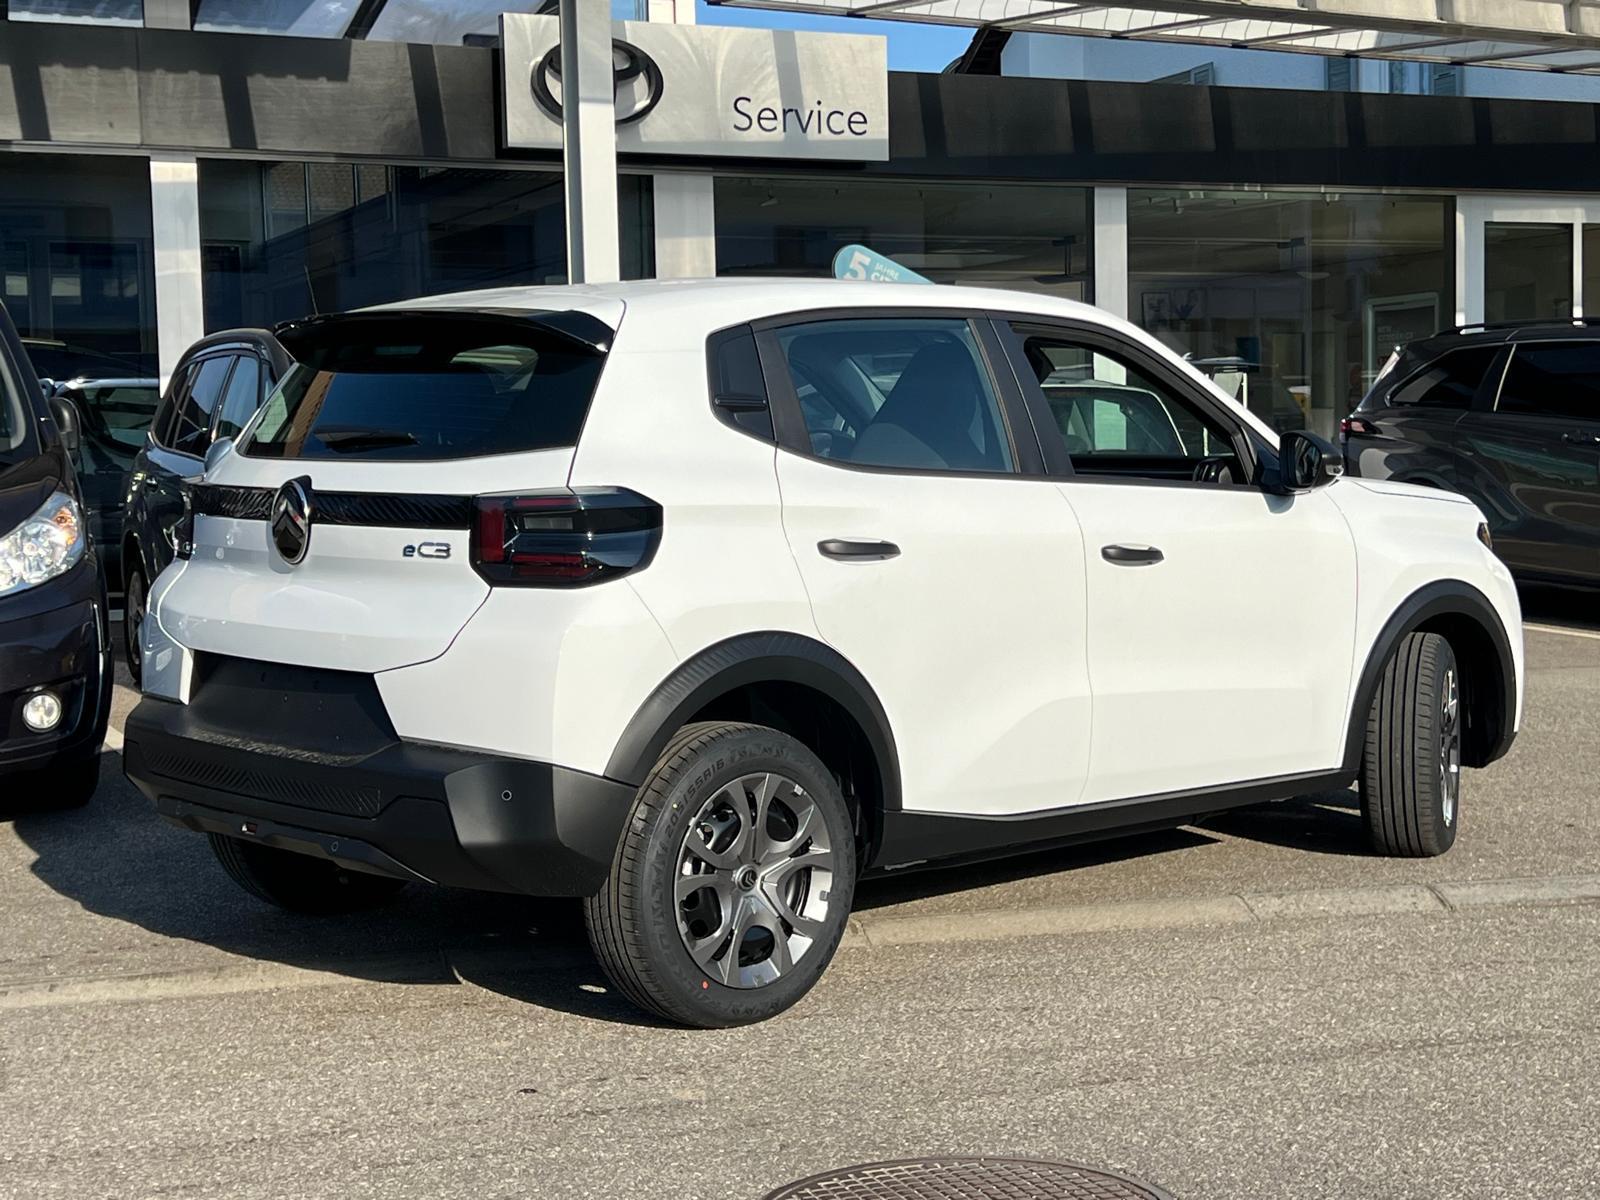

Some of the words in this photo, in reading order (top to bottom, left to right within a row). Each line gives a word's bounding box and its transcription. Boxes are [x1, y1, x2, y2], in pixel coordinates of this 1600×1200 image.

[733, 96, 868, 136] Service
[843, 250, 871, 281] 5
[402, 541, 452, 560] eC3
